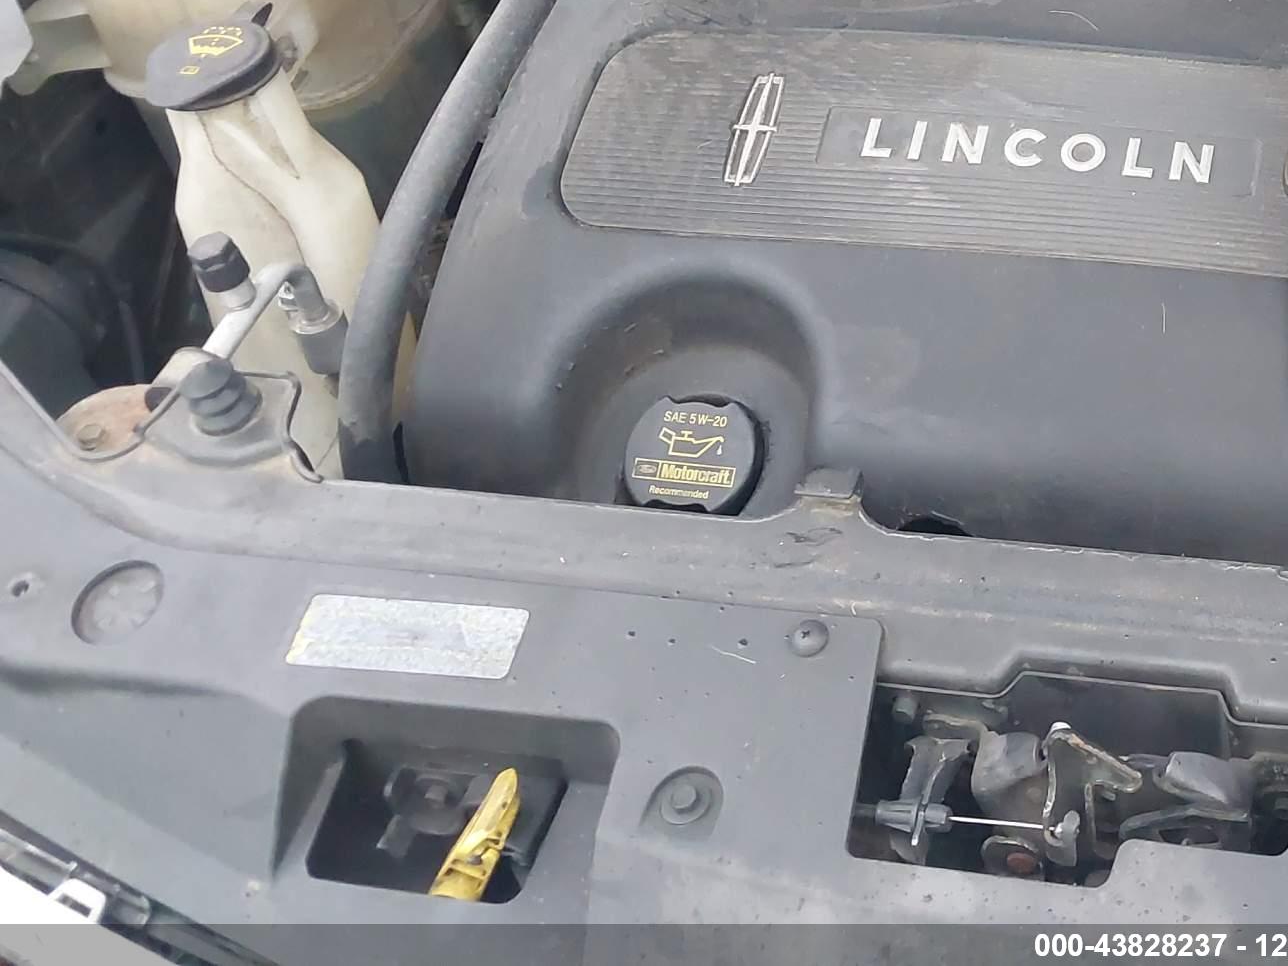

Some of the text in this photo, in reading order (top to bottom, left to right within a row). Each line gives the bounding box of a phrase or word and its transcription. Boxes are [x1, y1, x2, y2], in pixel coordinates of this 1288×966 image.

[860, 117, 1215, 184] LINCOLN
[663, 410, 727, 427] SAE 5W-20
[661, 463, 731, 484] Motorcraft
[649, 485, 709, 499] Recommended
